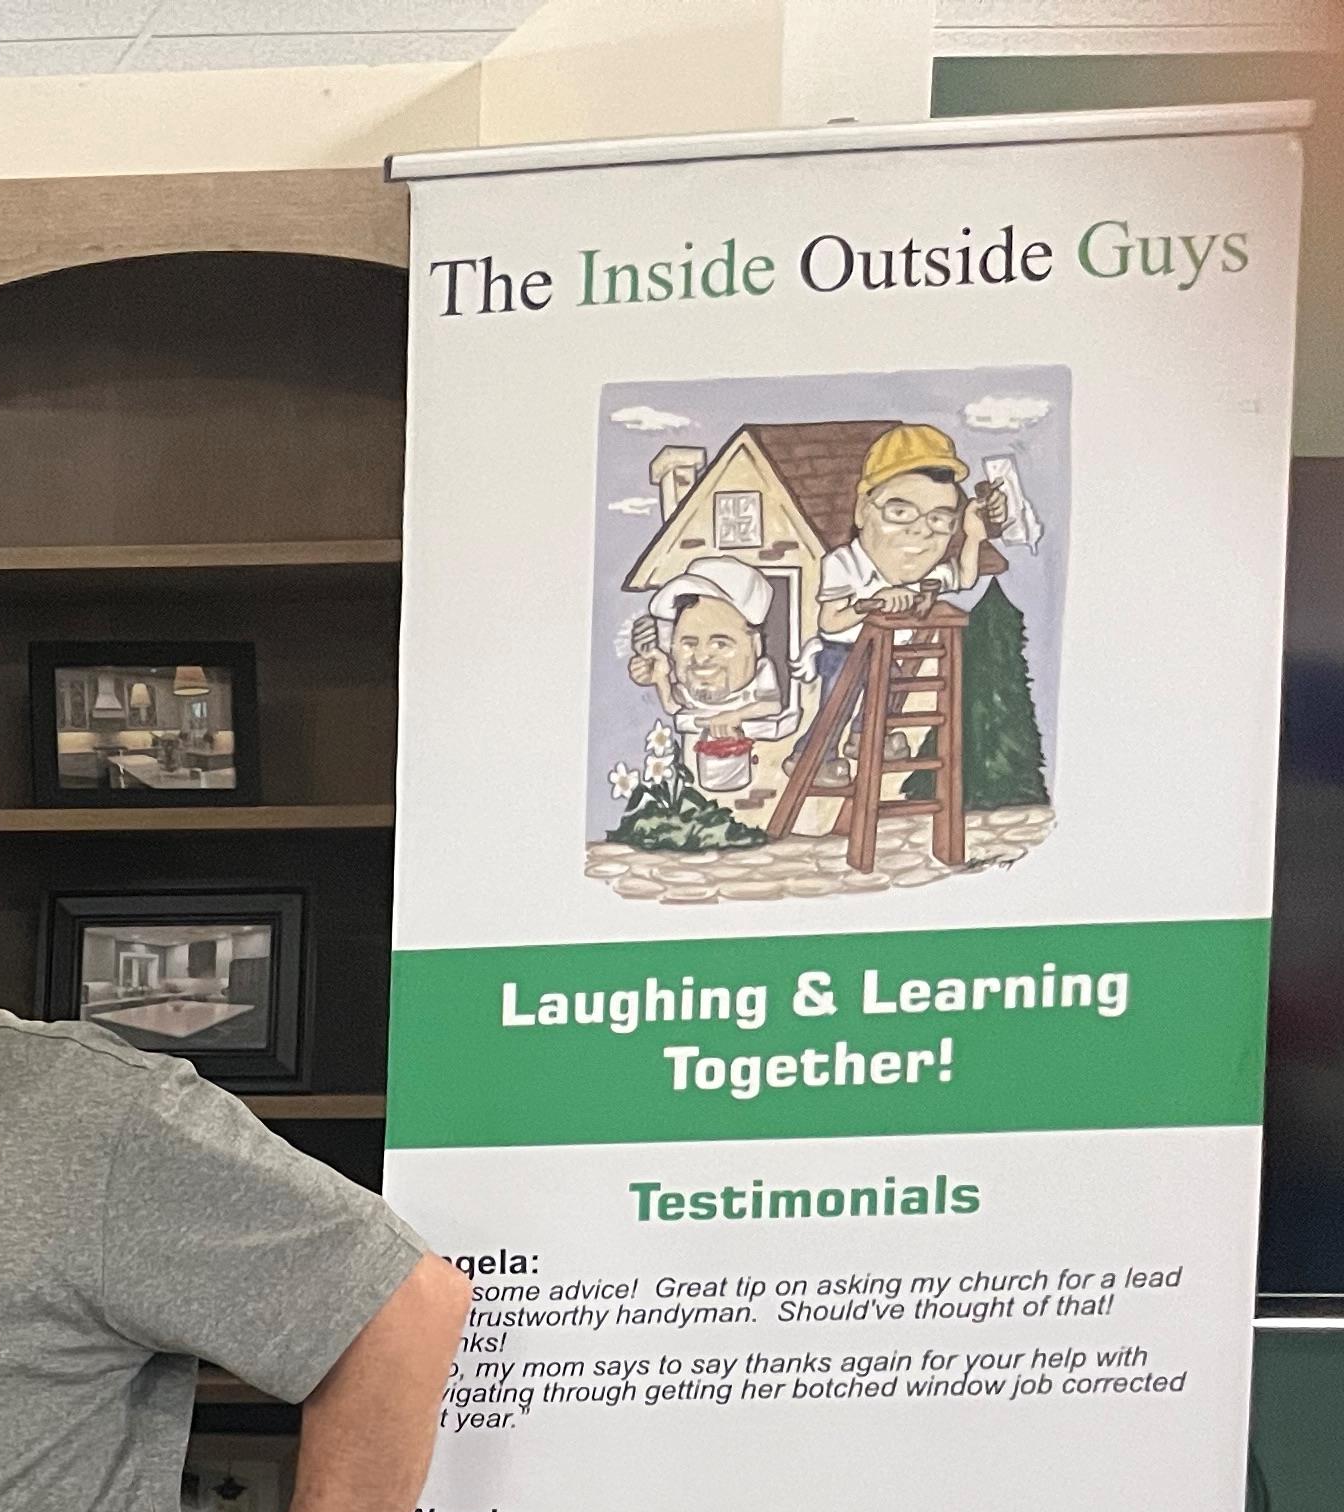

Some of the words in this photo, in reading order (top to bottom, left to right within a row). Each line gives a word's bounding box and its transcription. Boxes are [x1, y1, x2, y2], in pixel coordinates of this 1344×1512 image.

[429, 257, 553, 318] The
[576, 238, 777, 308] Inside
[799, 224, 1054, 295] Outside
[1077, 218, 1251, 292] Guys
[501, 973, 768, 1035] Laughing
[792, 970, 838, 1018] &
[862, 962, 1130, 1019] Learning
[663, 1038, 955, 1100] Together!
[628, 1174, 981, 1223] Testimonials
[442, 1248, 539, 1281] gela:
[549, 1278, 638, 1300] advice!
[656, 1277, 728, 1298] Great
[736, 1276, 766, 1302] tip
[775, 1280, 807, 1296] on
[817, 1273, 902, 1299] asking
[910, 1277, 951, 1298] my
[959, 1270, 1048, 1292] church
[1058, 1268, 1095, 1290] for
[1101, 1273, 1116, 1289] a
[1125, 1266, 1183, 1288] lead
[470, 1305, 609, 1331] trustworthy
[616, 1303, 756, 1329] handyman.
[778, 1299, 905, 1322] Should've
[915, 1297, 1014, 1323] thought
[1023, 1295, 1051, 1317] of
[1056, 1294, 1114, 1316] that!
